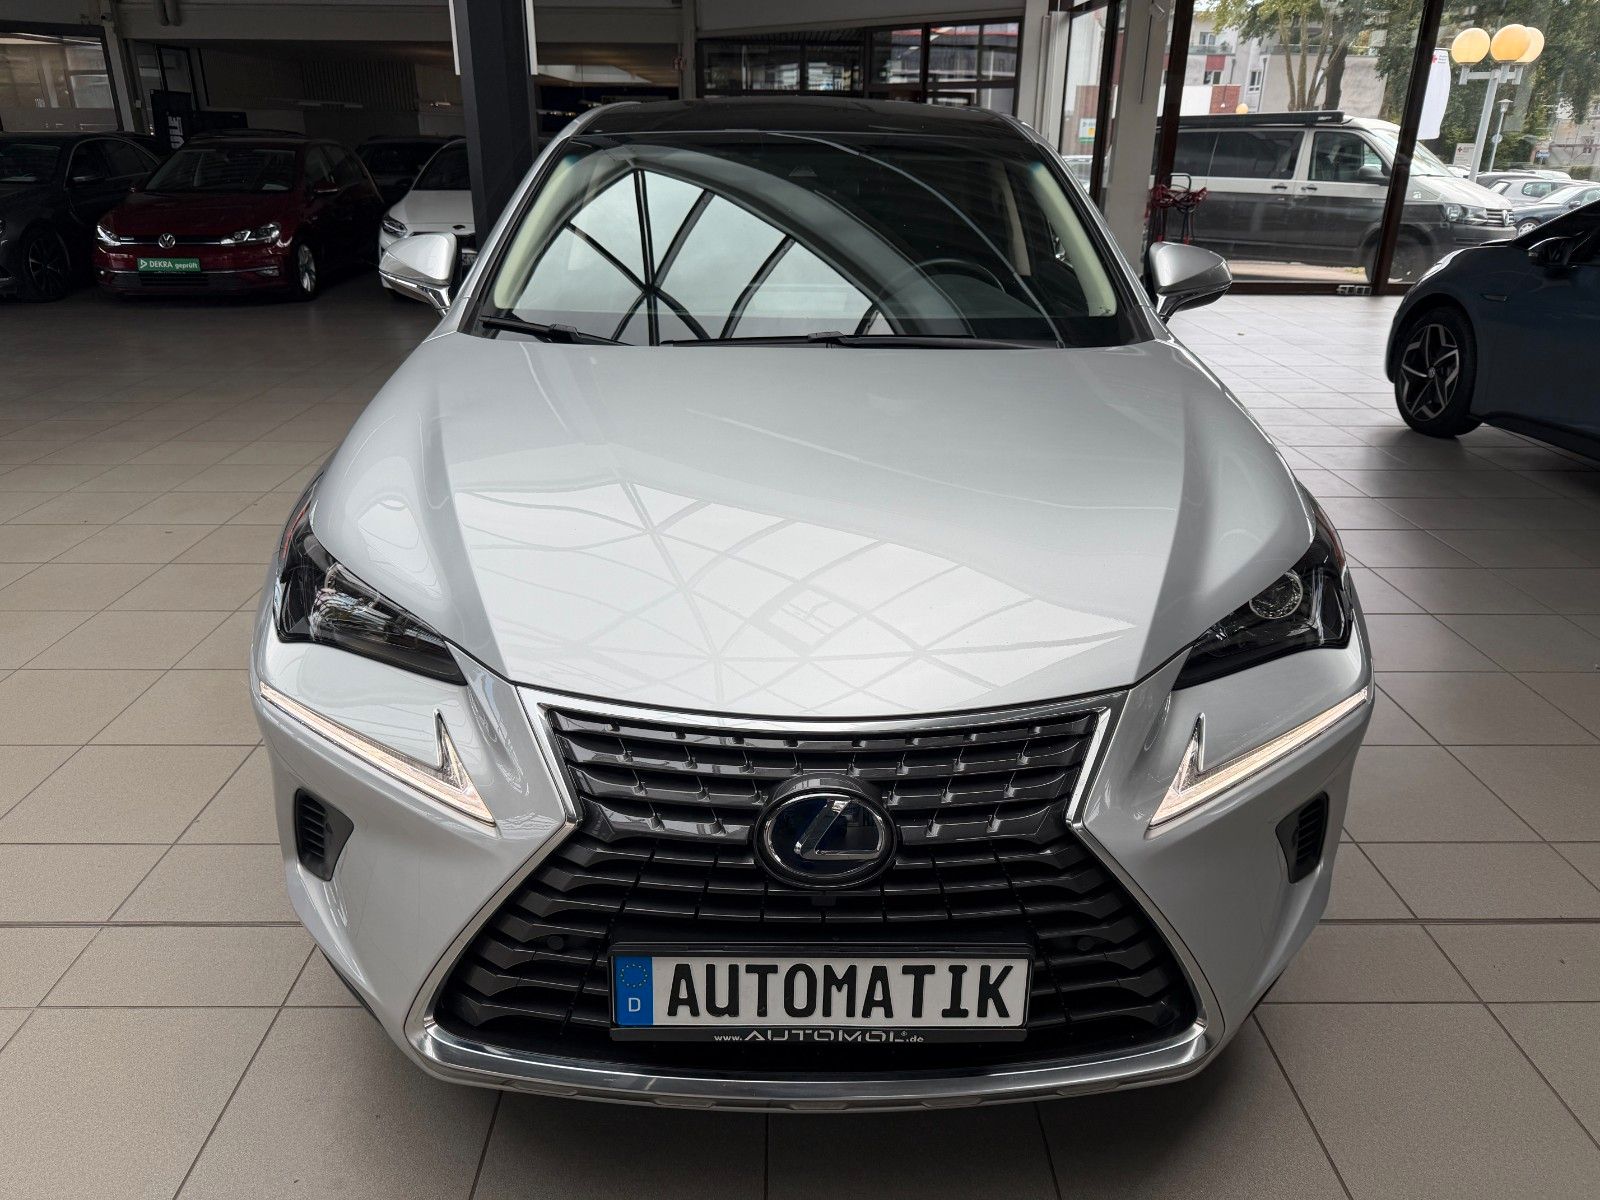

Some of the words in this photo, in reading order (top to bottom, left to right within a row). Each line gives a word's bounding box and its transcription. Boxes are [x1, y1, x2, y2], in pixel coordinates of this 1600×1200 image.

[149, 260, 173, 268] DEKRA
[174, 261, 198, 270] geprüft
[667, 963, 1013, 1019] AUTOMATIK
[628, 998, 641, 1013] D
